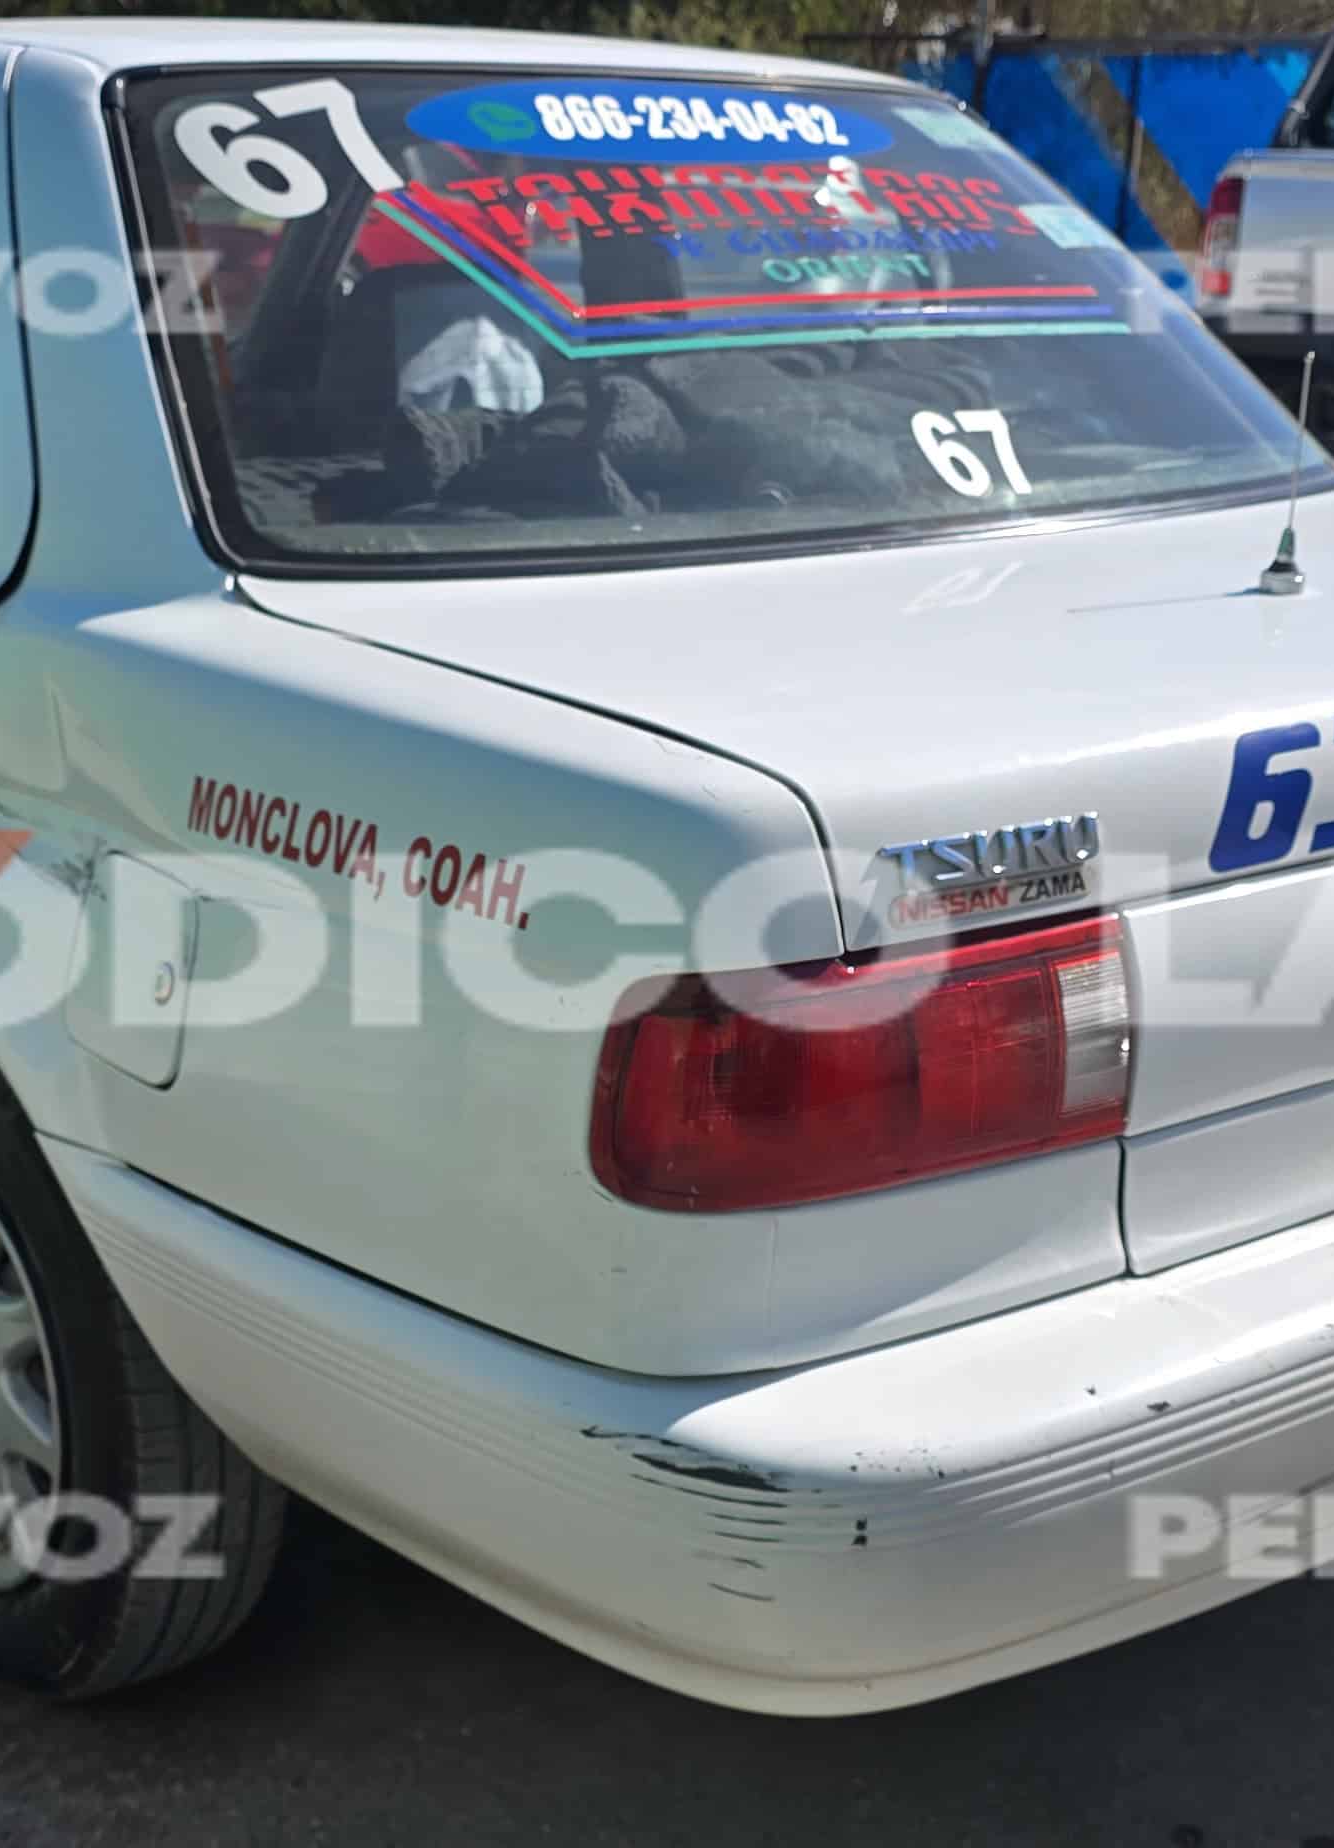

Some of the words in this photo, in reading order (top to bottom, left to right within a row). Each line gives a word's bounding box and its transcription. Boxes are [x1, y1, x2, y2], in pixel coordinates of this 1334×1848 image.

[174, 79, 405, 220] 67
[533, 93, 850, 147] 866-234-04-82
[911, 409, 1033, 498] 67
[188, 774, 386, 901] MONCLOVA,
[402, 836, 530, 931] COAH.
[875, 810, 1100, 889] TSURU
[897, 883, 1010, 925] NISSAN
[1018, 871, 1087, 904] ZAMA
